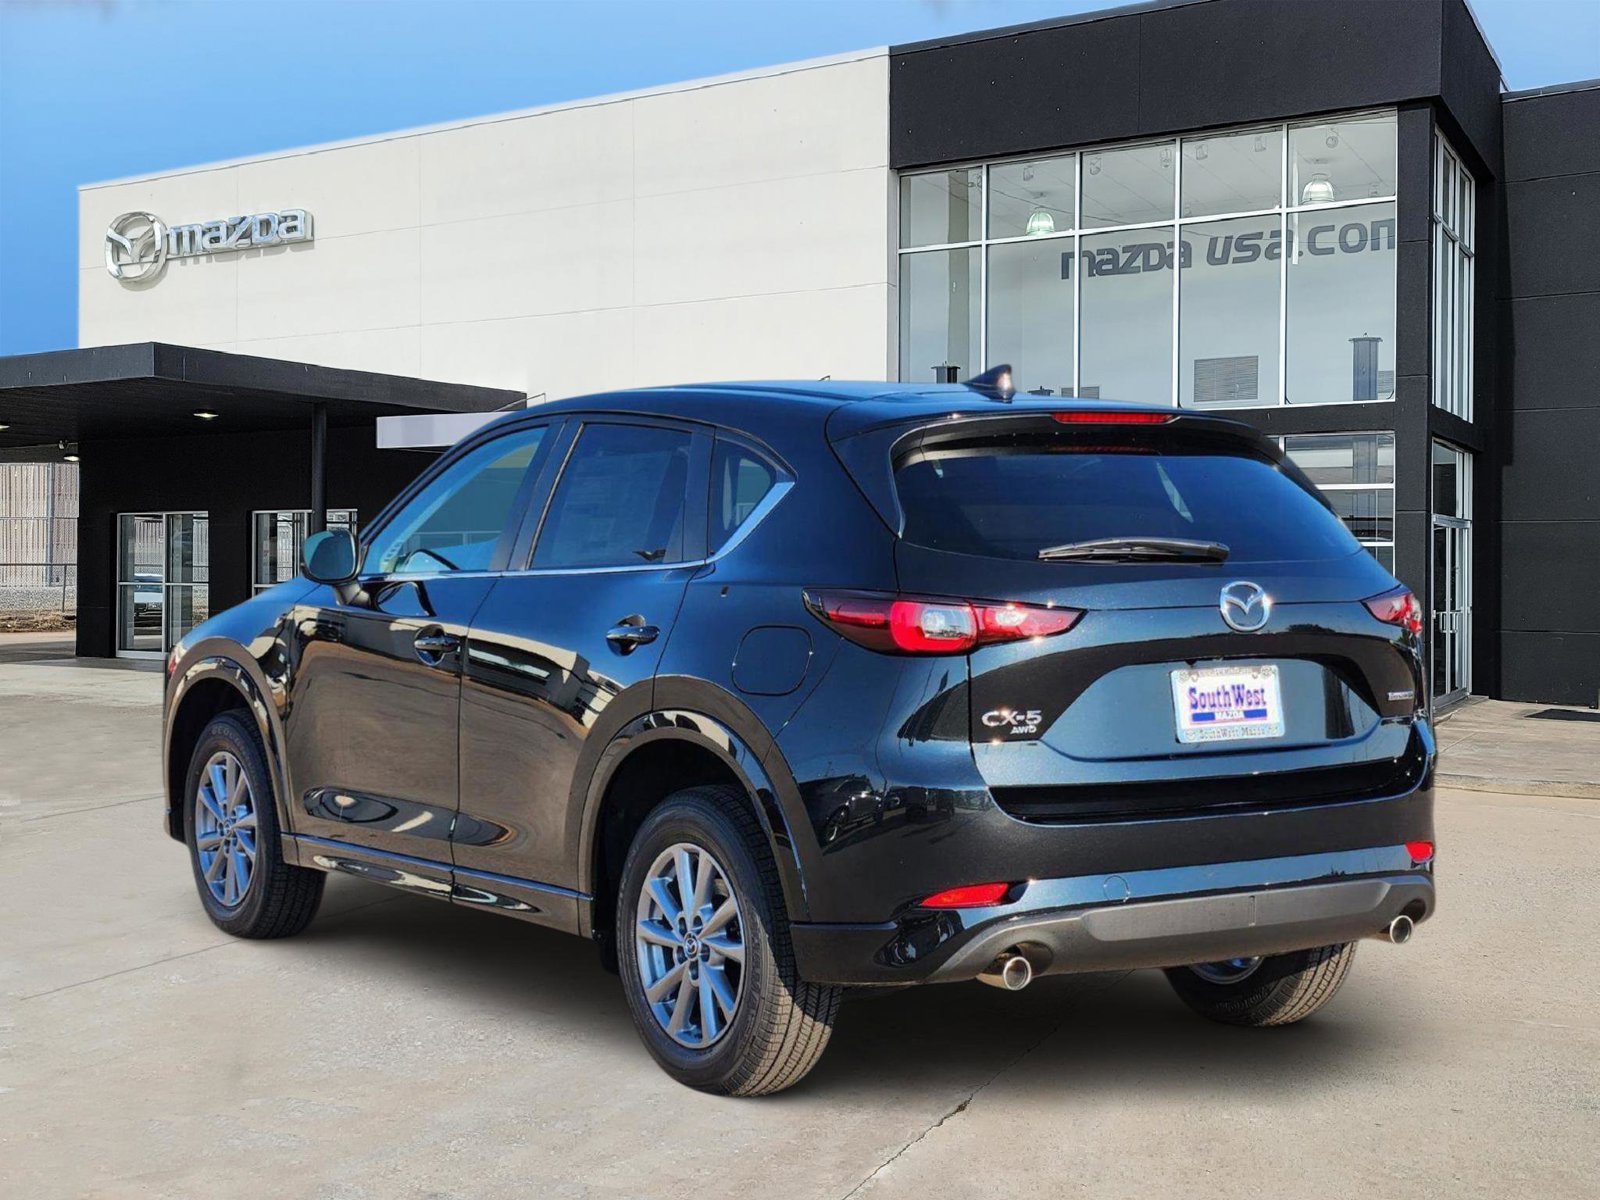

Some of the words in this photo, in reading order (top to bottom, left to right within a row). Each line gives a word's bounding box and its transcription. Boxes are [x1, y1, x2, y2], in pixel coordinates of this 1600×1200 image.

[166, 208, 312, 256] mazda
[1061, 240, 1192, 280] mazda
[981, 709, 1042, 727] CX-5
[1010, 726, 1037, 735] AWD
